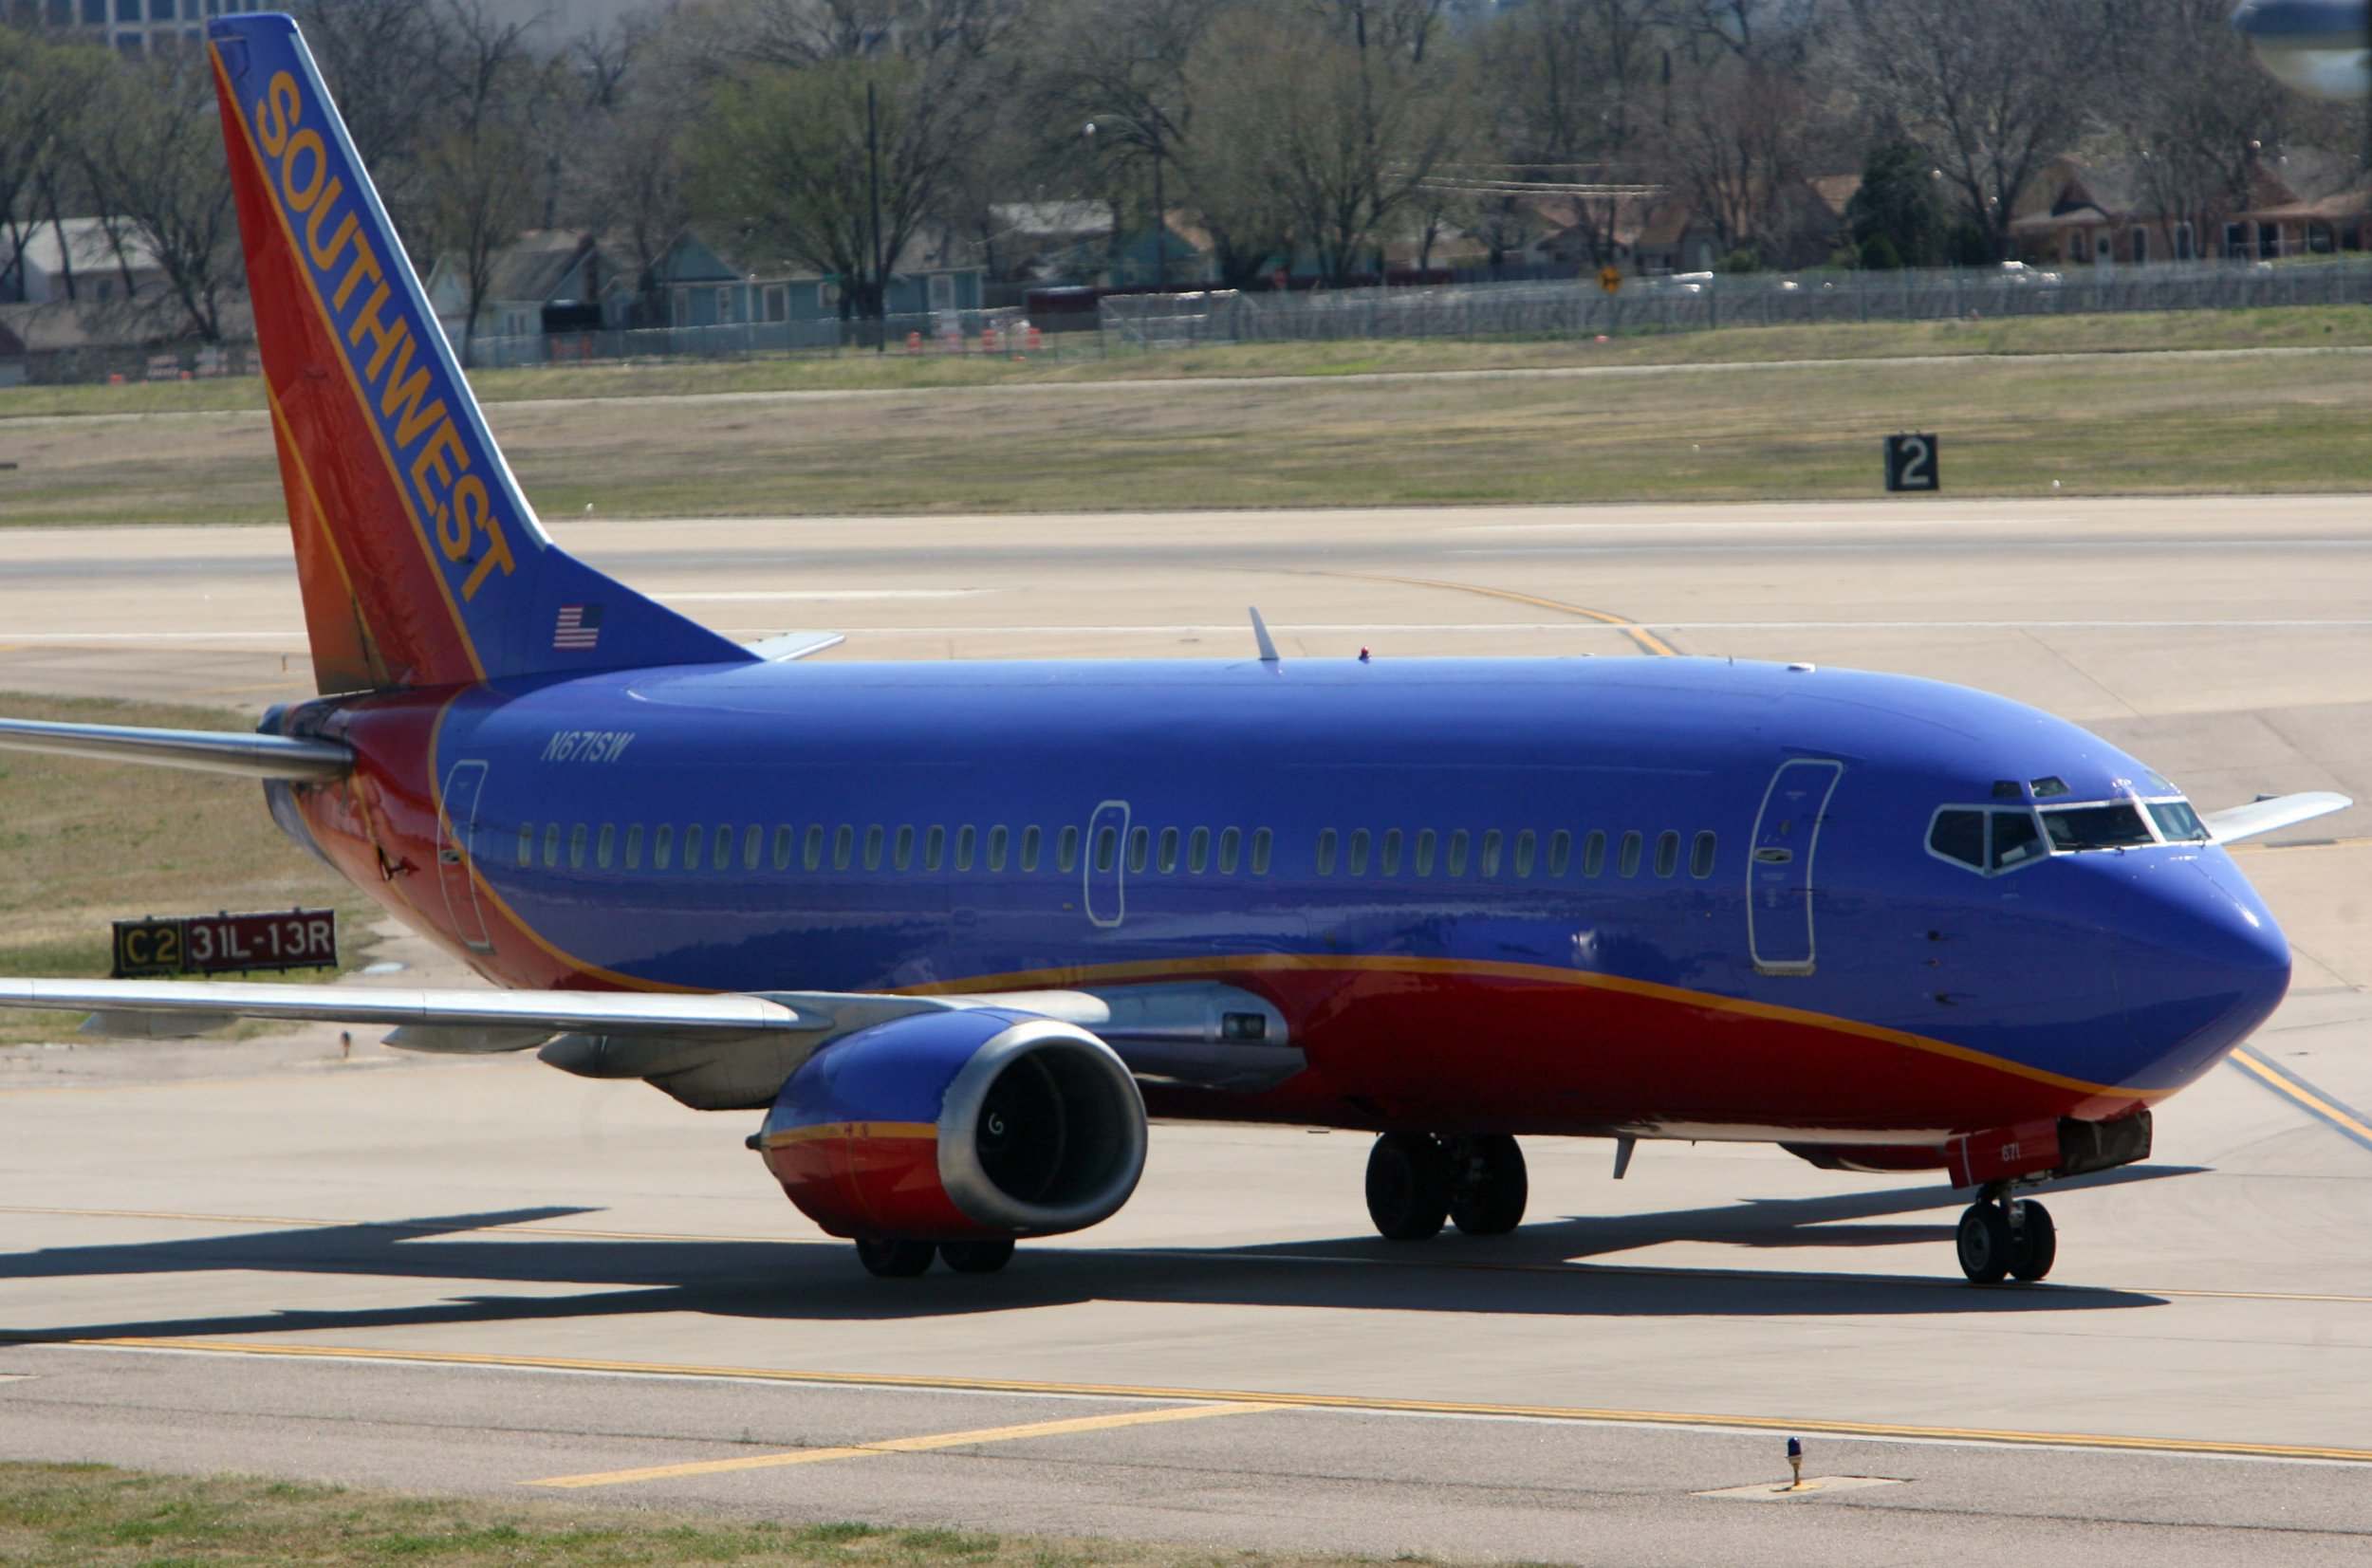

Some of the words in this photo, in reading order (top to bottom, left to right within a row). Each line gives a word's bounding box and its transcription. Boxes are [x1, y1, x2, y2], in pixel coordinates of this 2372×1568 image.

[256, 71, 515, 601] SOUTHWEST
[1901, 437, 1929, 485] 2
[540, 731, 636, 762] N671SW
[126, 929, 177, 963] C2
[192, 920, 330, 961] 31L-13R
[2002, 1143, 2020, 1162] 671
